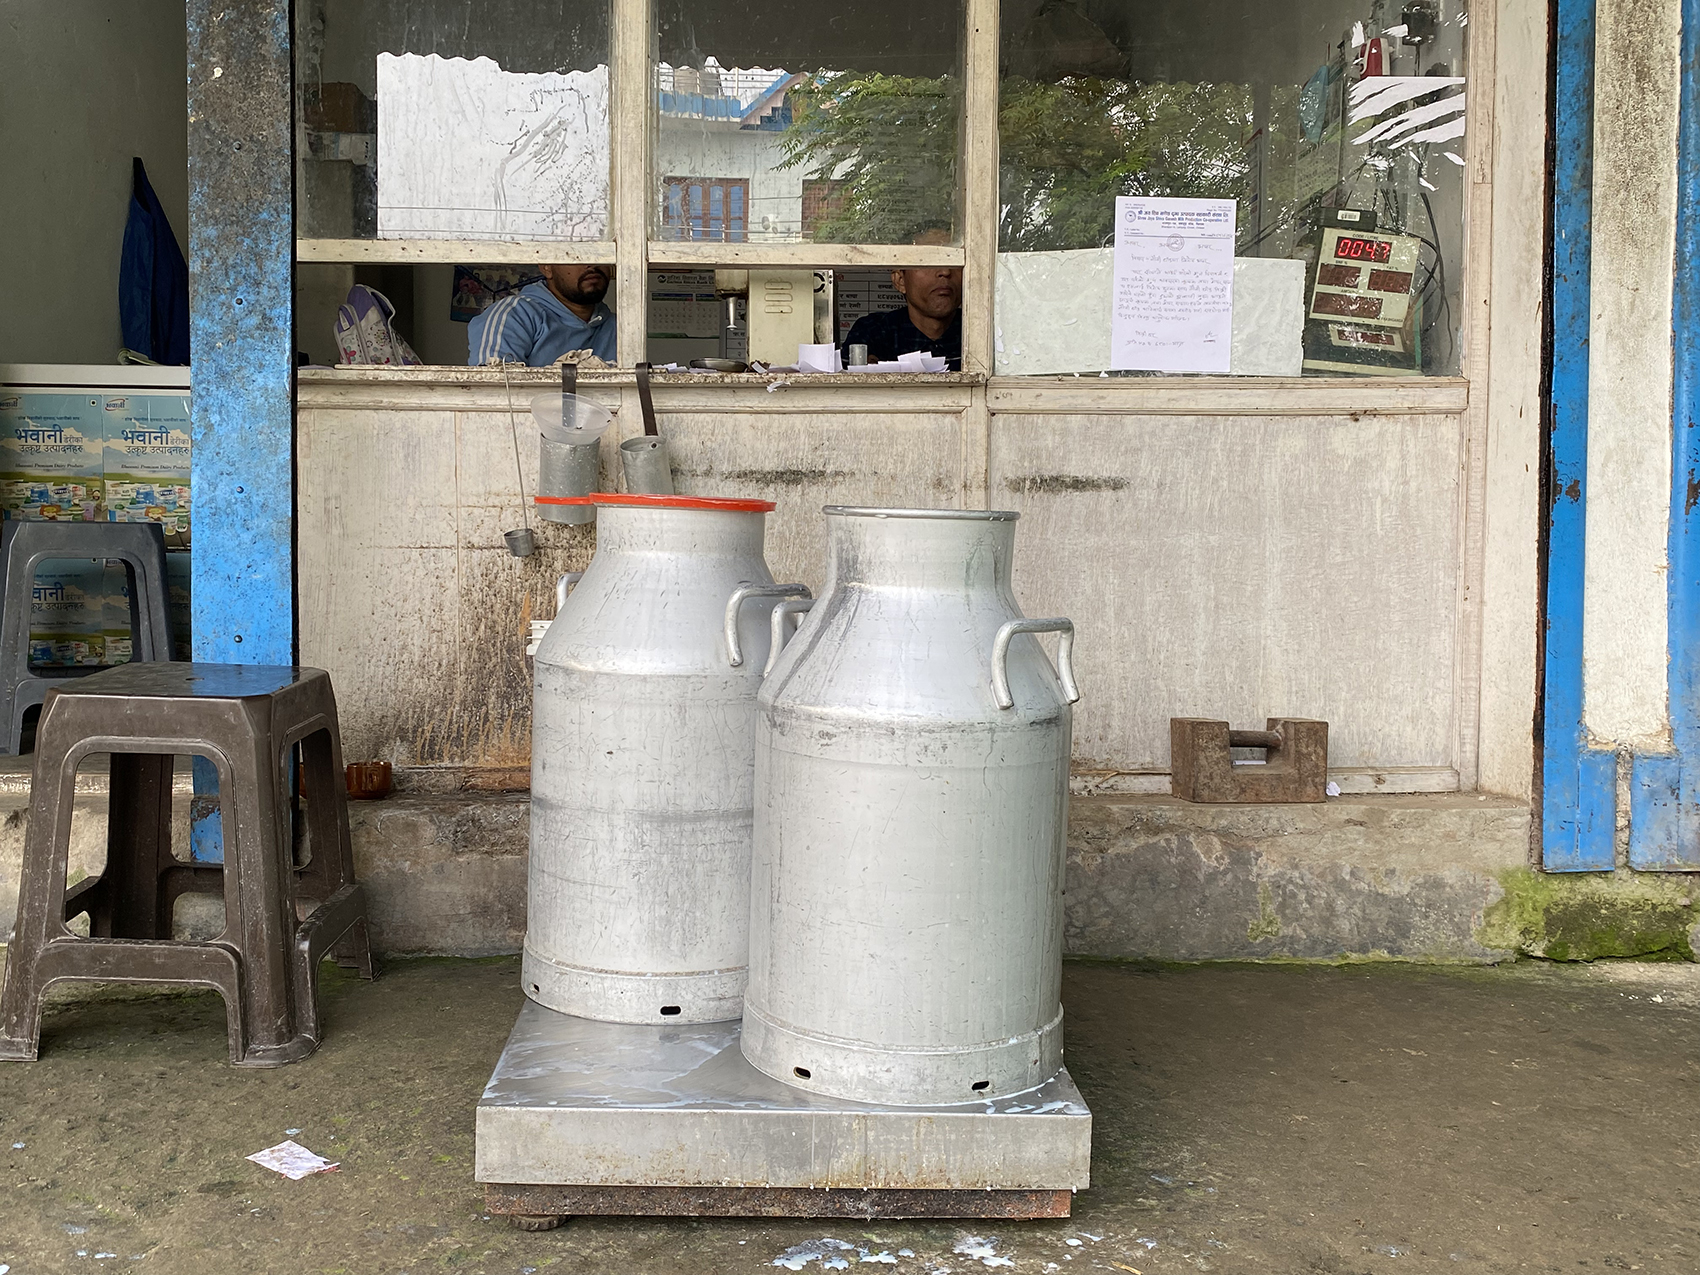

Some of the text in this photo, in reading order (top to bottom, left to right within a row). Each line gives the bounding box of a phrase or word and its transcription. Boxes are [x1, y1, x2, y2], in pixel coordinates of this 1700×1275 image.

[15, 424, 64, 443] भवानी
[121, 425, 170, 445] भवानी
[19, 445, 41, 455] उत्कृष्ट
[125, 446, 147, 456] उत्कृष्ट
[32, 582, 65, 601] वानी
